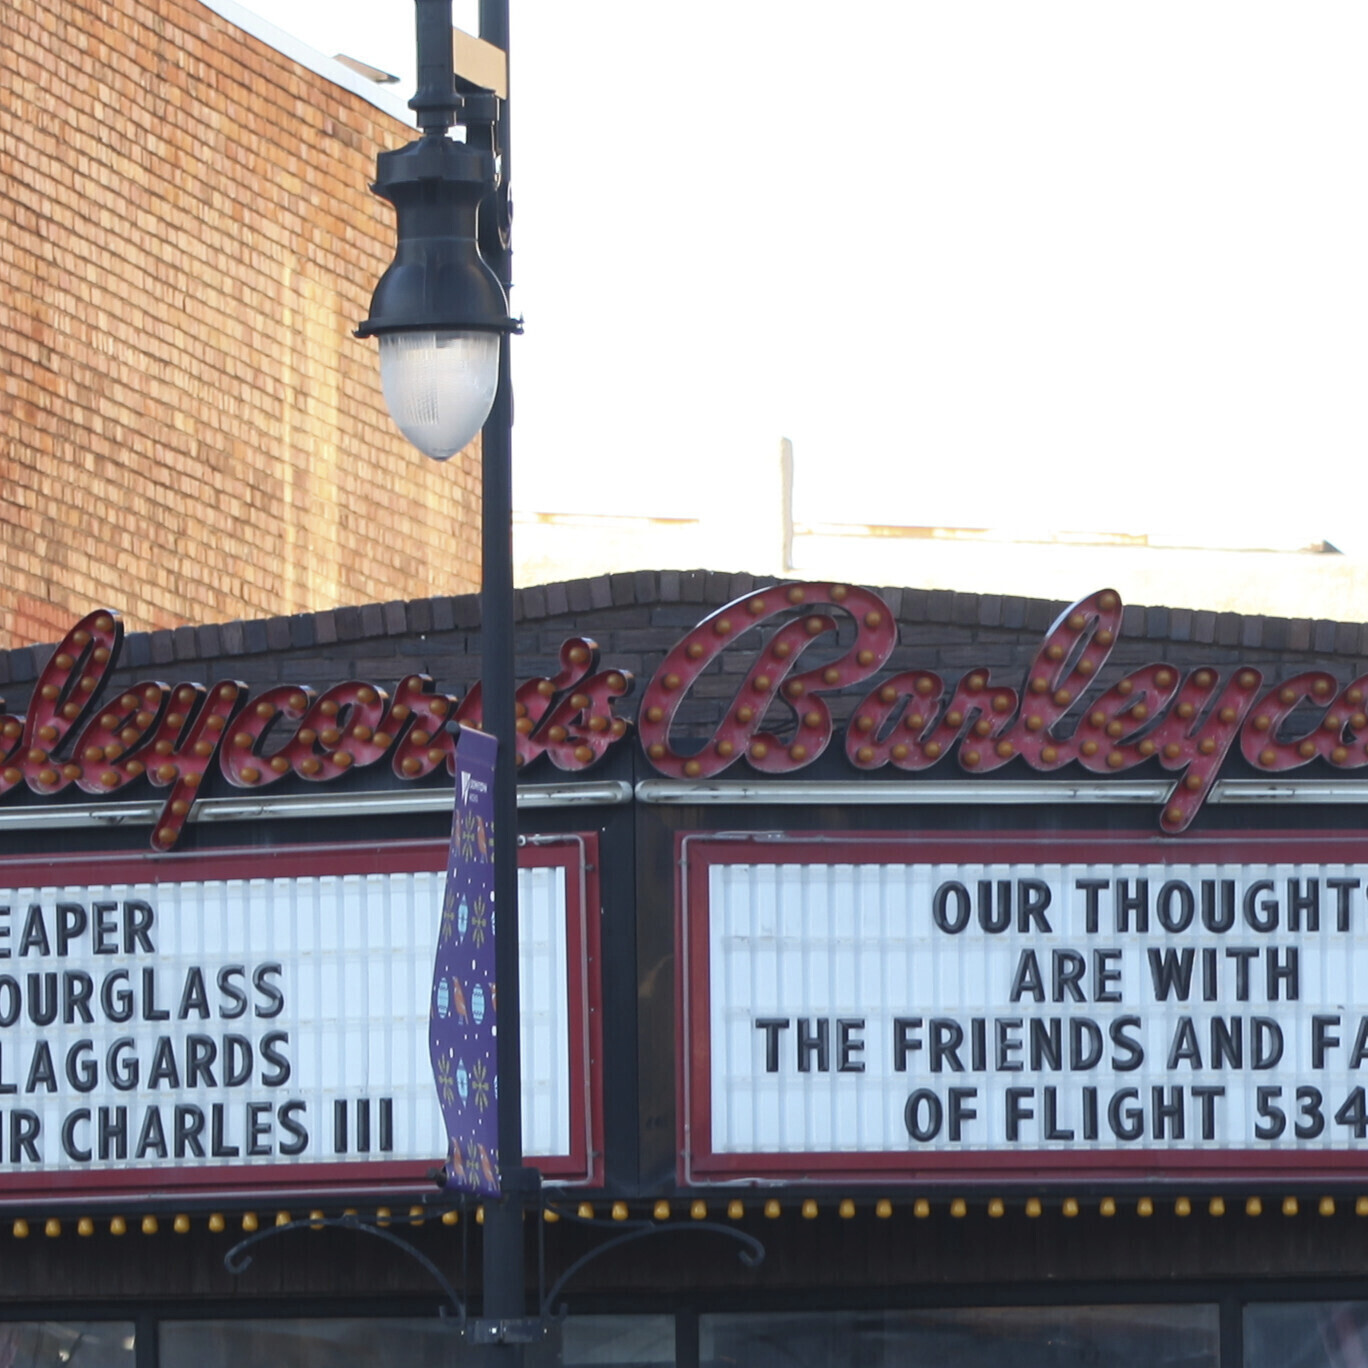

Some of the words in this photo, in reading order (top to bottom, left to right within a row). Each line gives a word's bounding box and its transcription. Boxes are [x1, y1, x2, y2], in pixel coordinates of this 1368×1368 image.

[932, 878, 1053, 935] OUR
[1009, 947, 1123, 1002] ARE
[1147, 946, 1300, 1002] WITH
[754, 1017, 866, 1073] THE
[892, 1015, 1145, 1073] FRIENDS
[1165, 1015, 1284, 1071] AND
[61, 1100, 310, 1163] CHARLES
[333, 1097, 394, 1153] III
[903, 1086, 978, 1143] OF
[1004, 1085, 1226, 1142] FLIGHT
